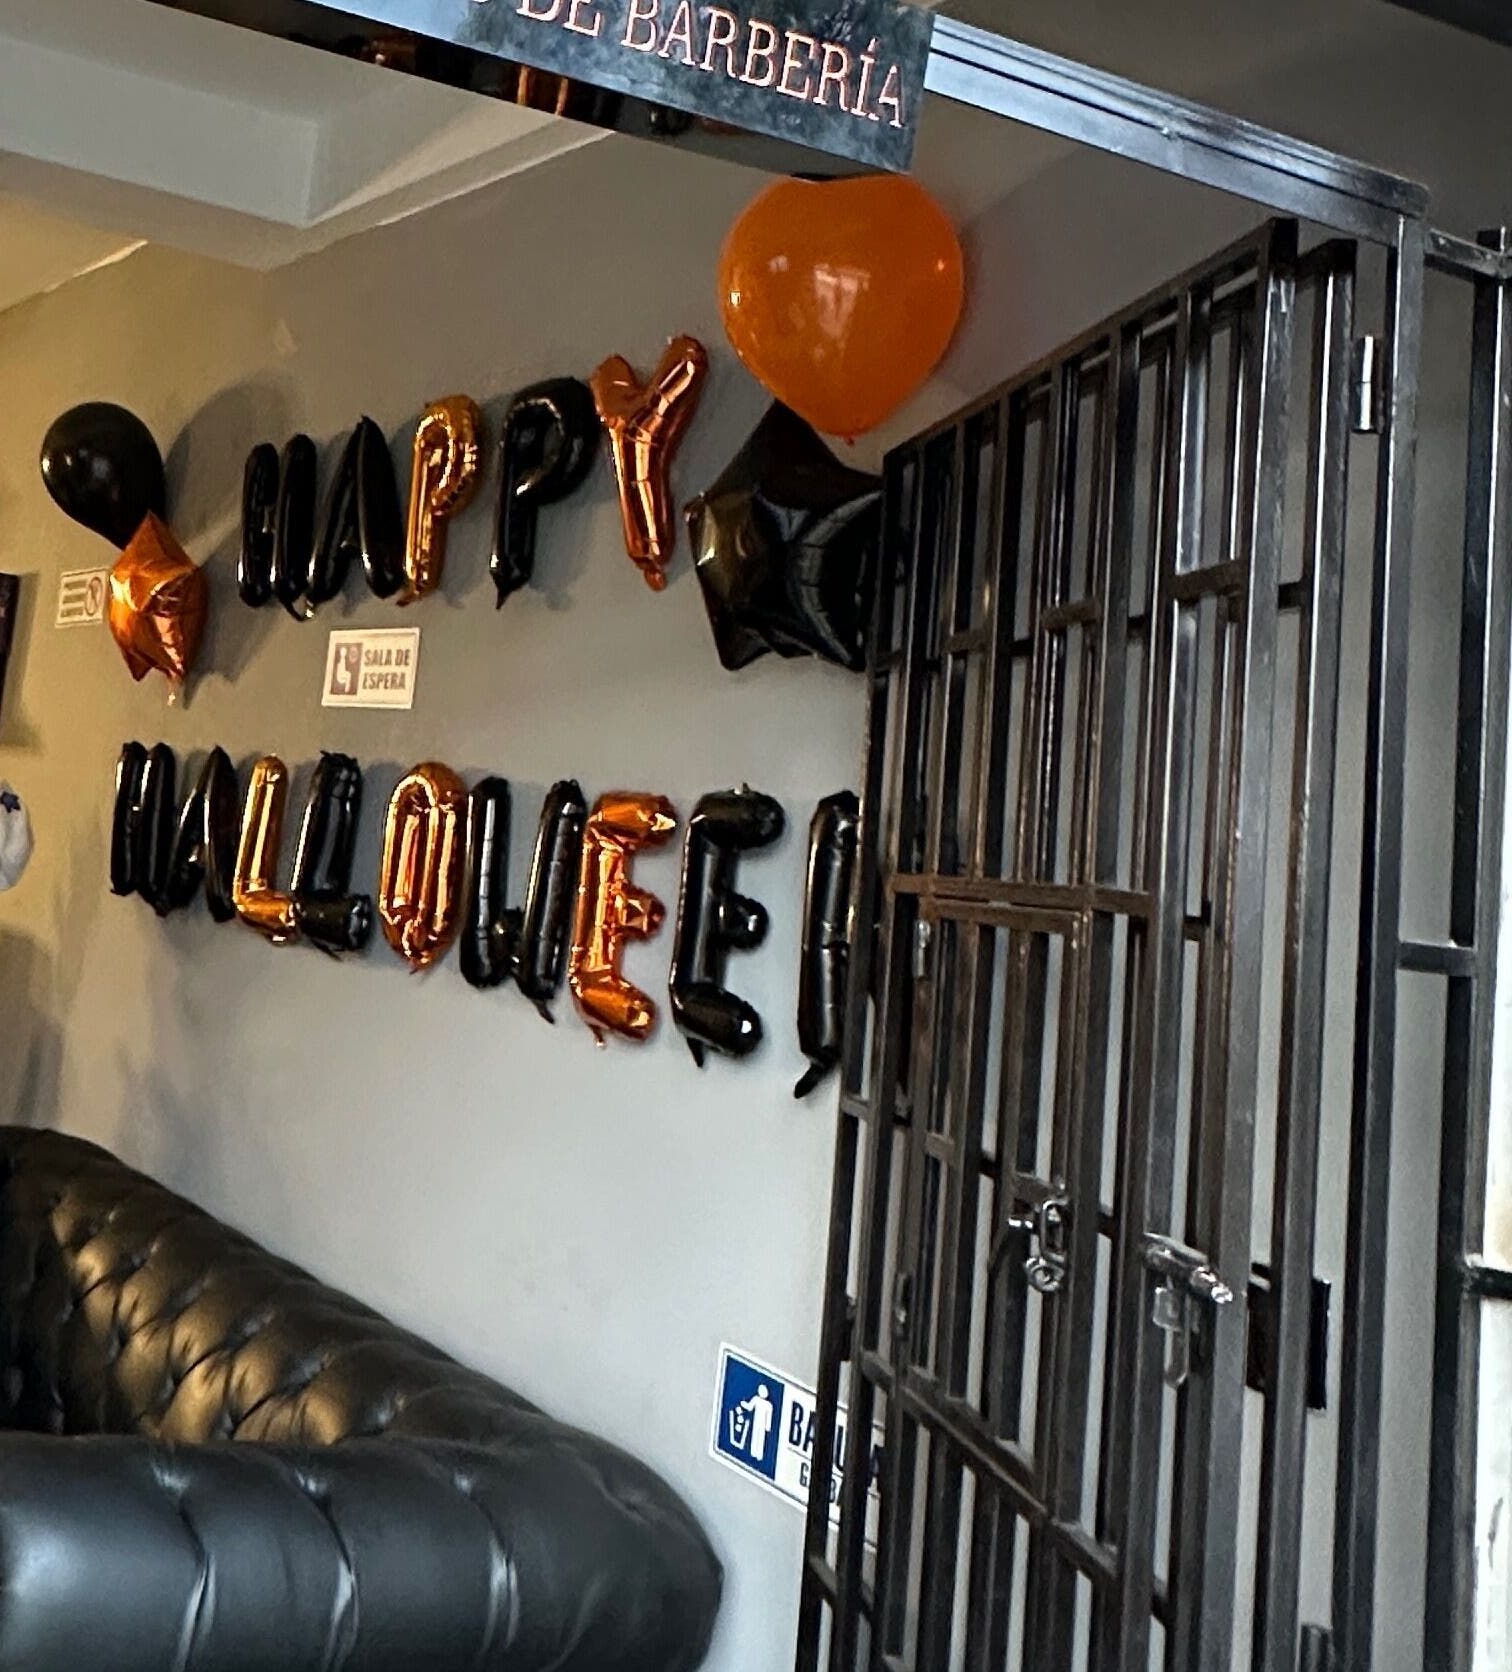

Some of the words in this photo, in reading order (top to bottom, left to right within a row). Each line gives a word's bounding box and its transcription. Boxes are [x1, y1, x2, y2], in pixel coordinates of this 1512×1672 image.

[621, 0, 904, 129] BARBERÍA
[237, 335, 708, 614] HAPPY
[362, 672, 406, 690] ESPERA
[364, 648, 392, 667] SALA
[394, 648, 410, 667] DE
